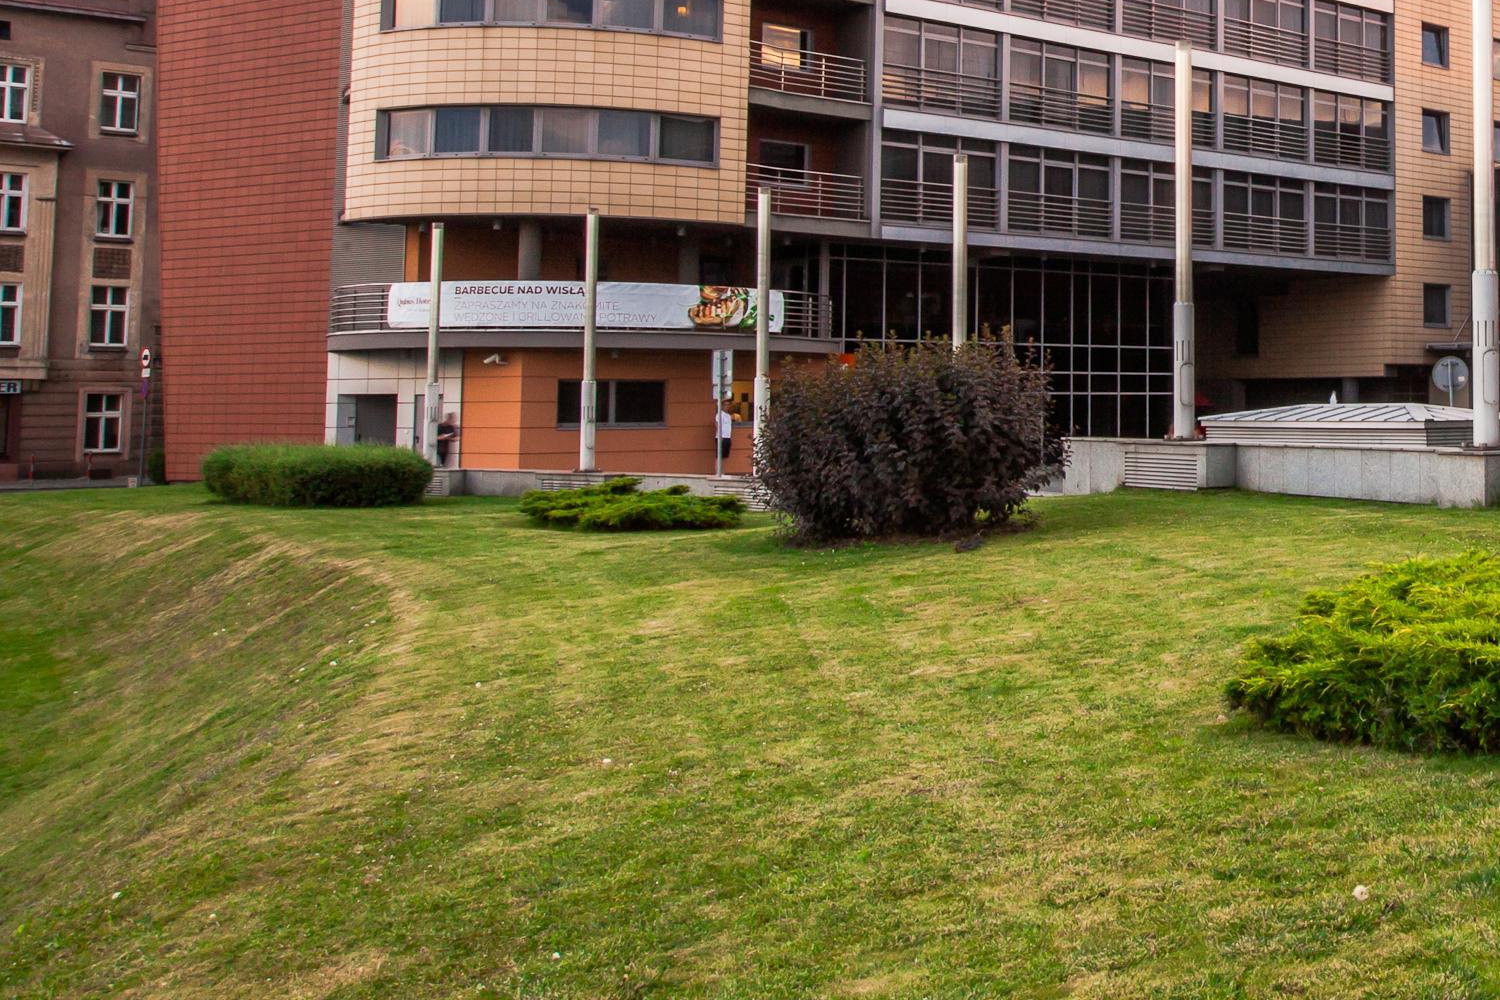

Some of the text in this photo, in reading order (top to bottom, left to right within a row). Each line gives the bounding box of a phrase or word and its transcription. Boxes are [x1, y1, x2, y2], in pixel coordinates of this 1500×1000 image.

[455, 285, 585, 298] BARBECUE NAD WISŁĄ
[454, 299, 527, 311] ZAPRASZAMY
[531, 299, 548, 310] NA
[600, 312, 657, 323] POTRAWY
